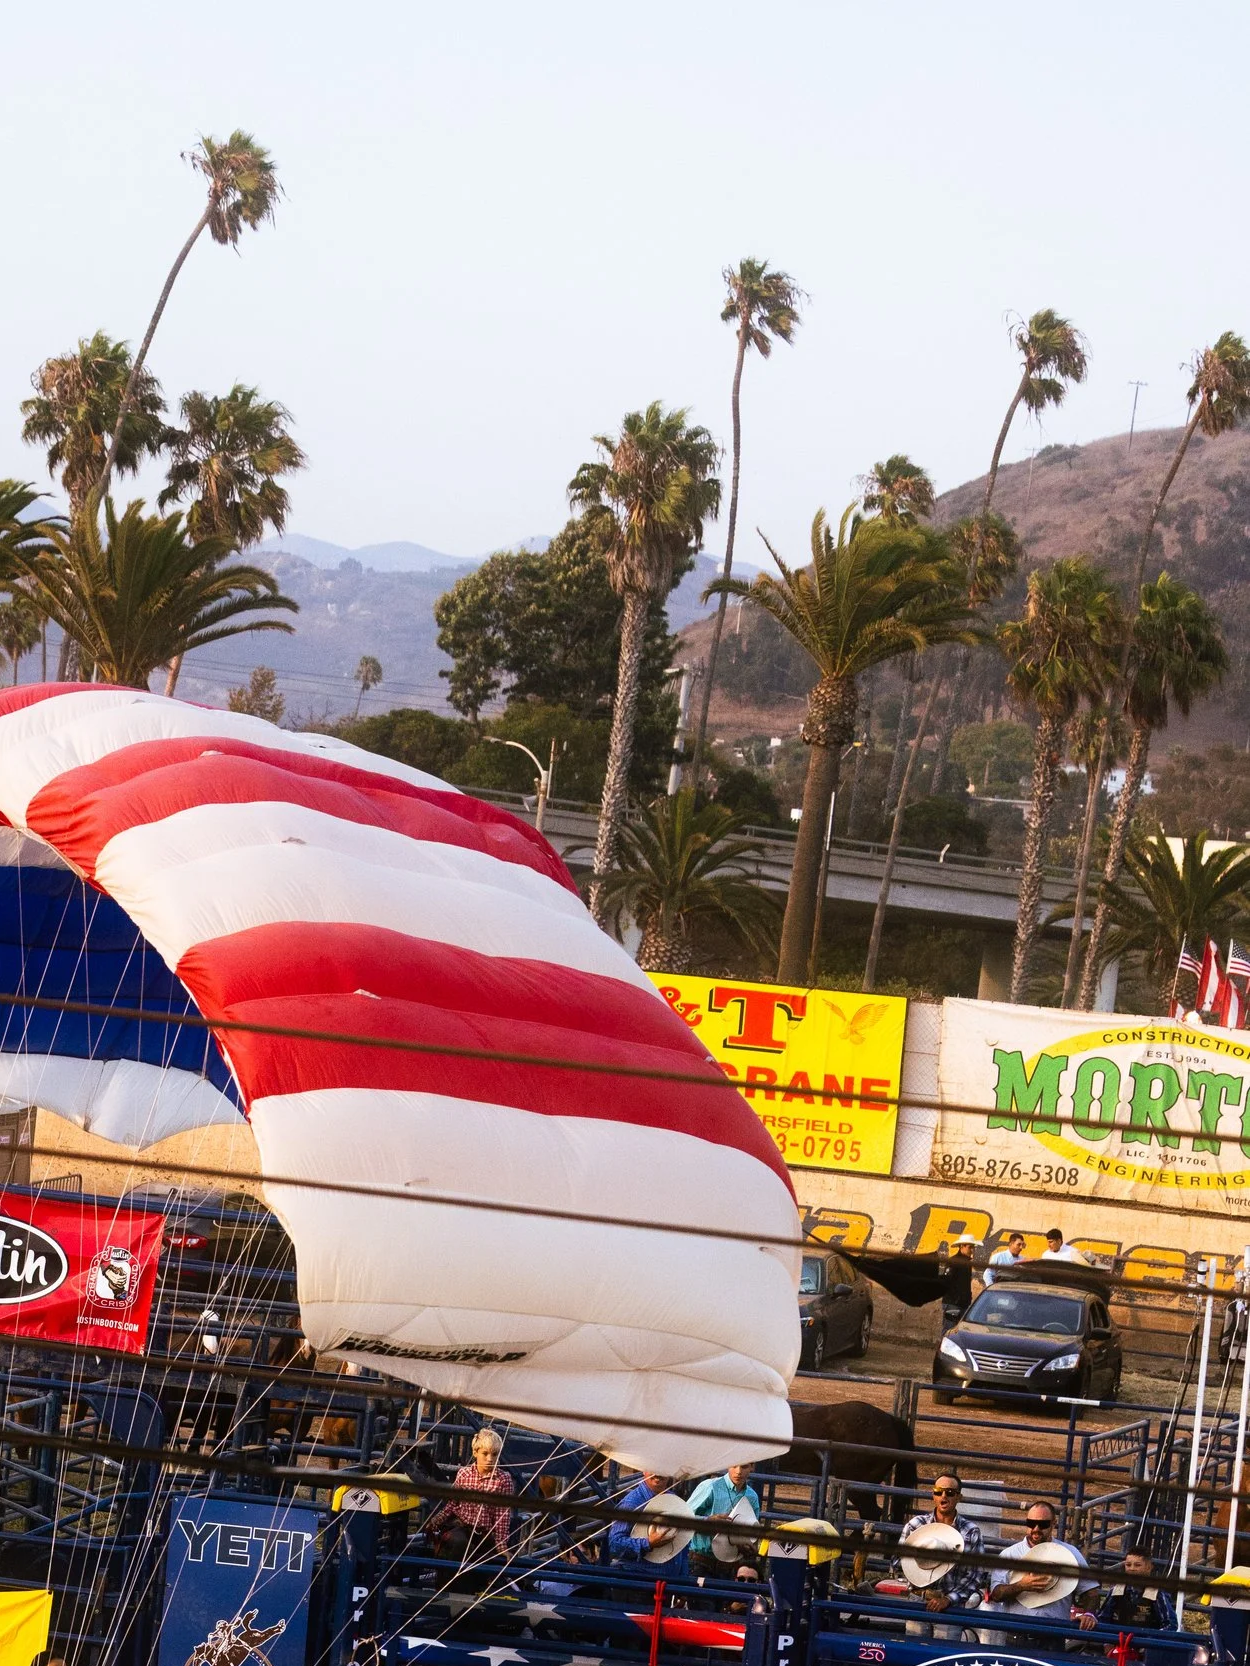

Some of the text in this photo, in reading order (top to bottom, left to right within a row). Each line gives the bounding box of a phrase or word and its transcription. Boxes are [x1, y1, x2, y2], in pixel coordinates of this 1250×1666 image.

[708, 986, 808, 1054] T
[776, 1132, 862, 1163] 3-0795
[940, 1153, 1080, 1187] 805-876-5308
[1085, 1154, 1245, 1187] ENGINEERING
[76, 1315, 139, 1334] JUSTINBOOTS.COM
[177, 1518, 307, 1573] YETI
[858, 1648, 886, 1662] 250
[859, 1641, 886, 1650] AMERICA
